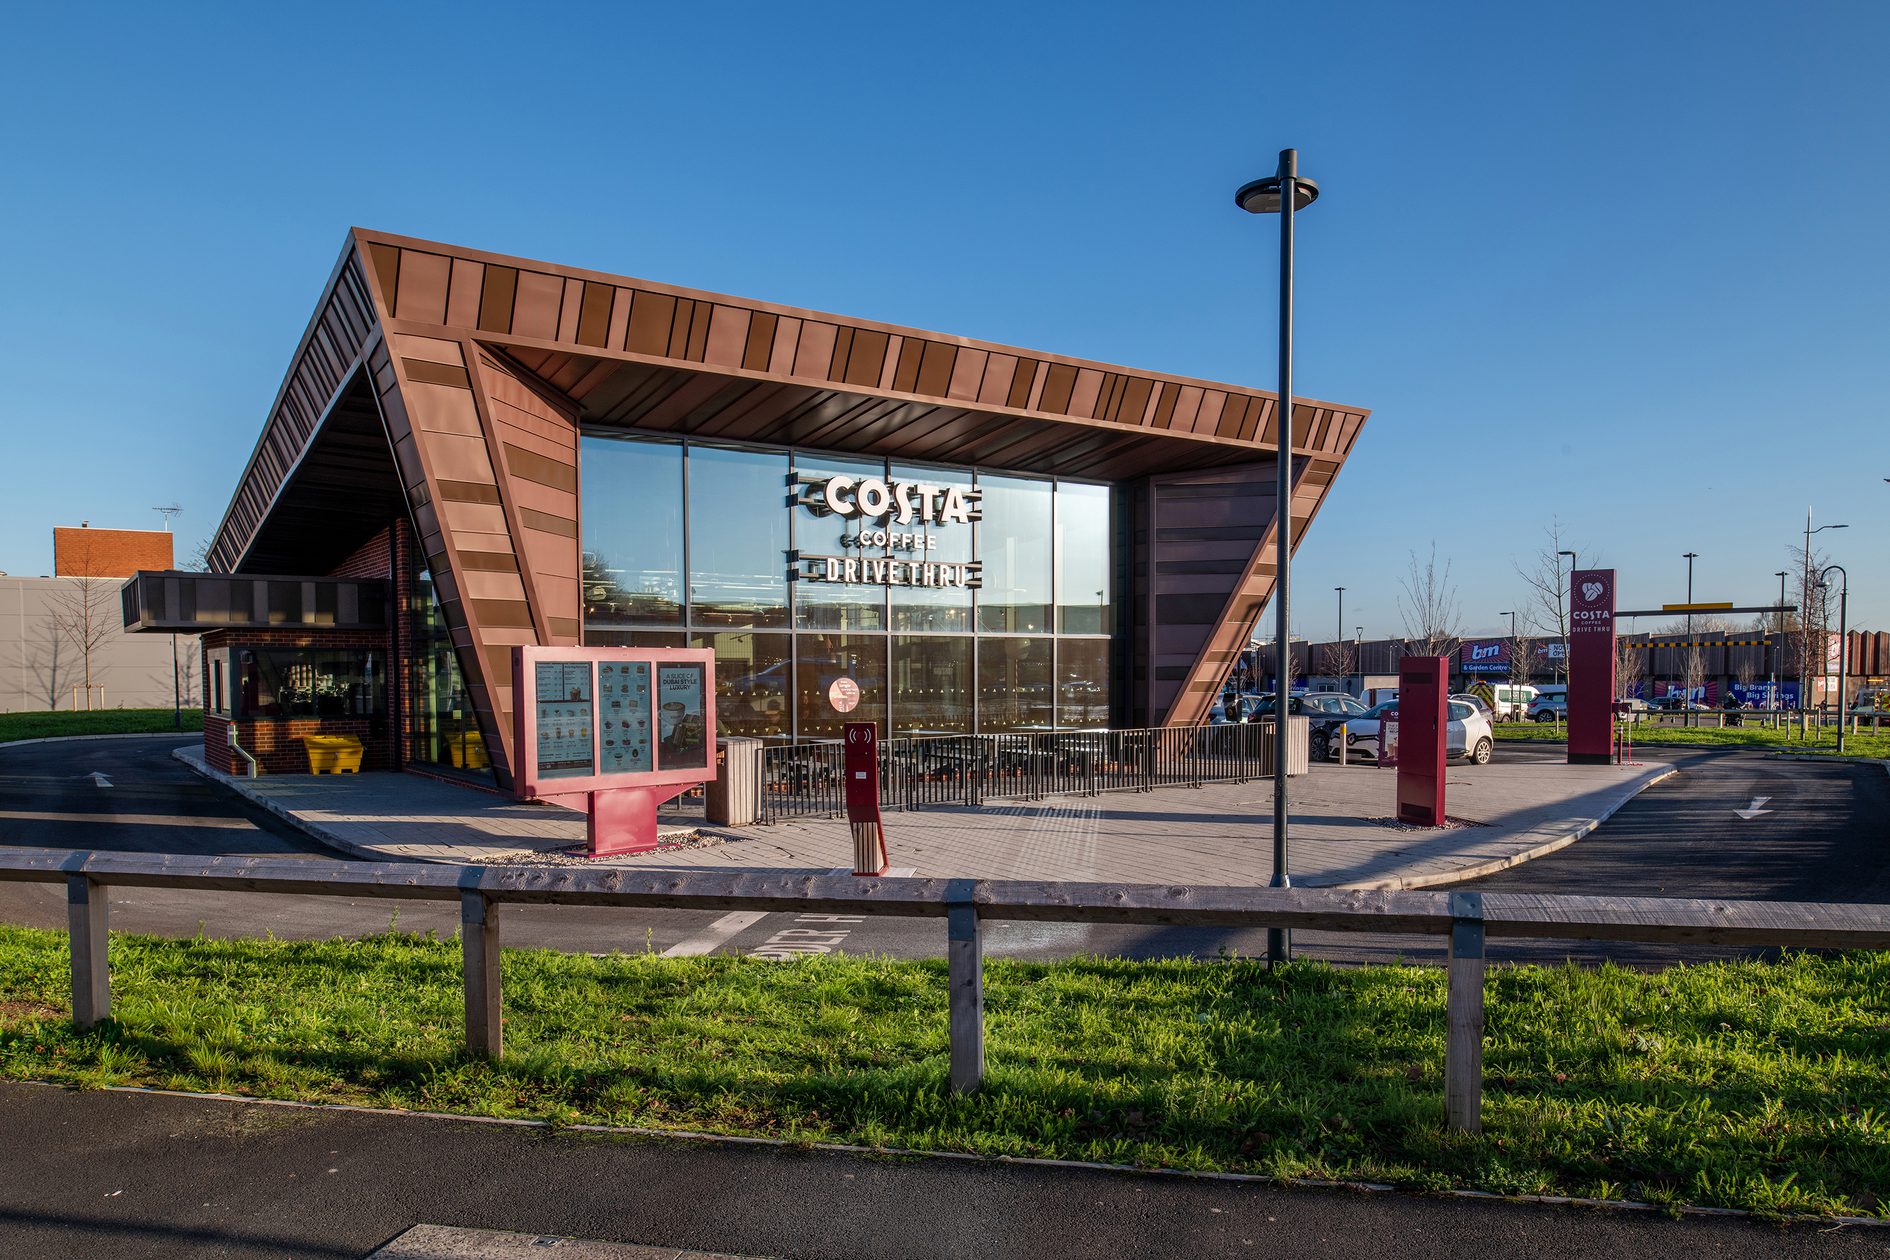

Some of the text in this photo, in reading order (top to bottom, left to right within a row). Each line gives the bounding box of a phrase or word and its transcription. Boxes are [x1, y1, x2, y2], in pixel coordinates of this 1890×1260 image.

[824, 475, 969, 525] COSTA
[859, 530, 937, 550] COFFEE
[826, 557, 966, 587] DRIVE THRU
[1573, 610, 1610, 620] COSTA
[1734, 683, 1747, 692] Big
[1746, 691, 1794, 700] Big Sings
